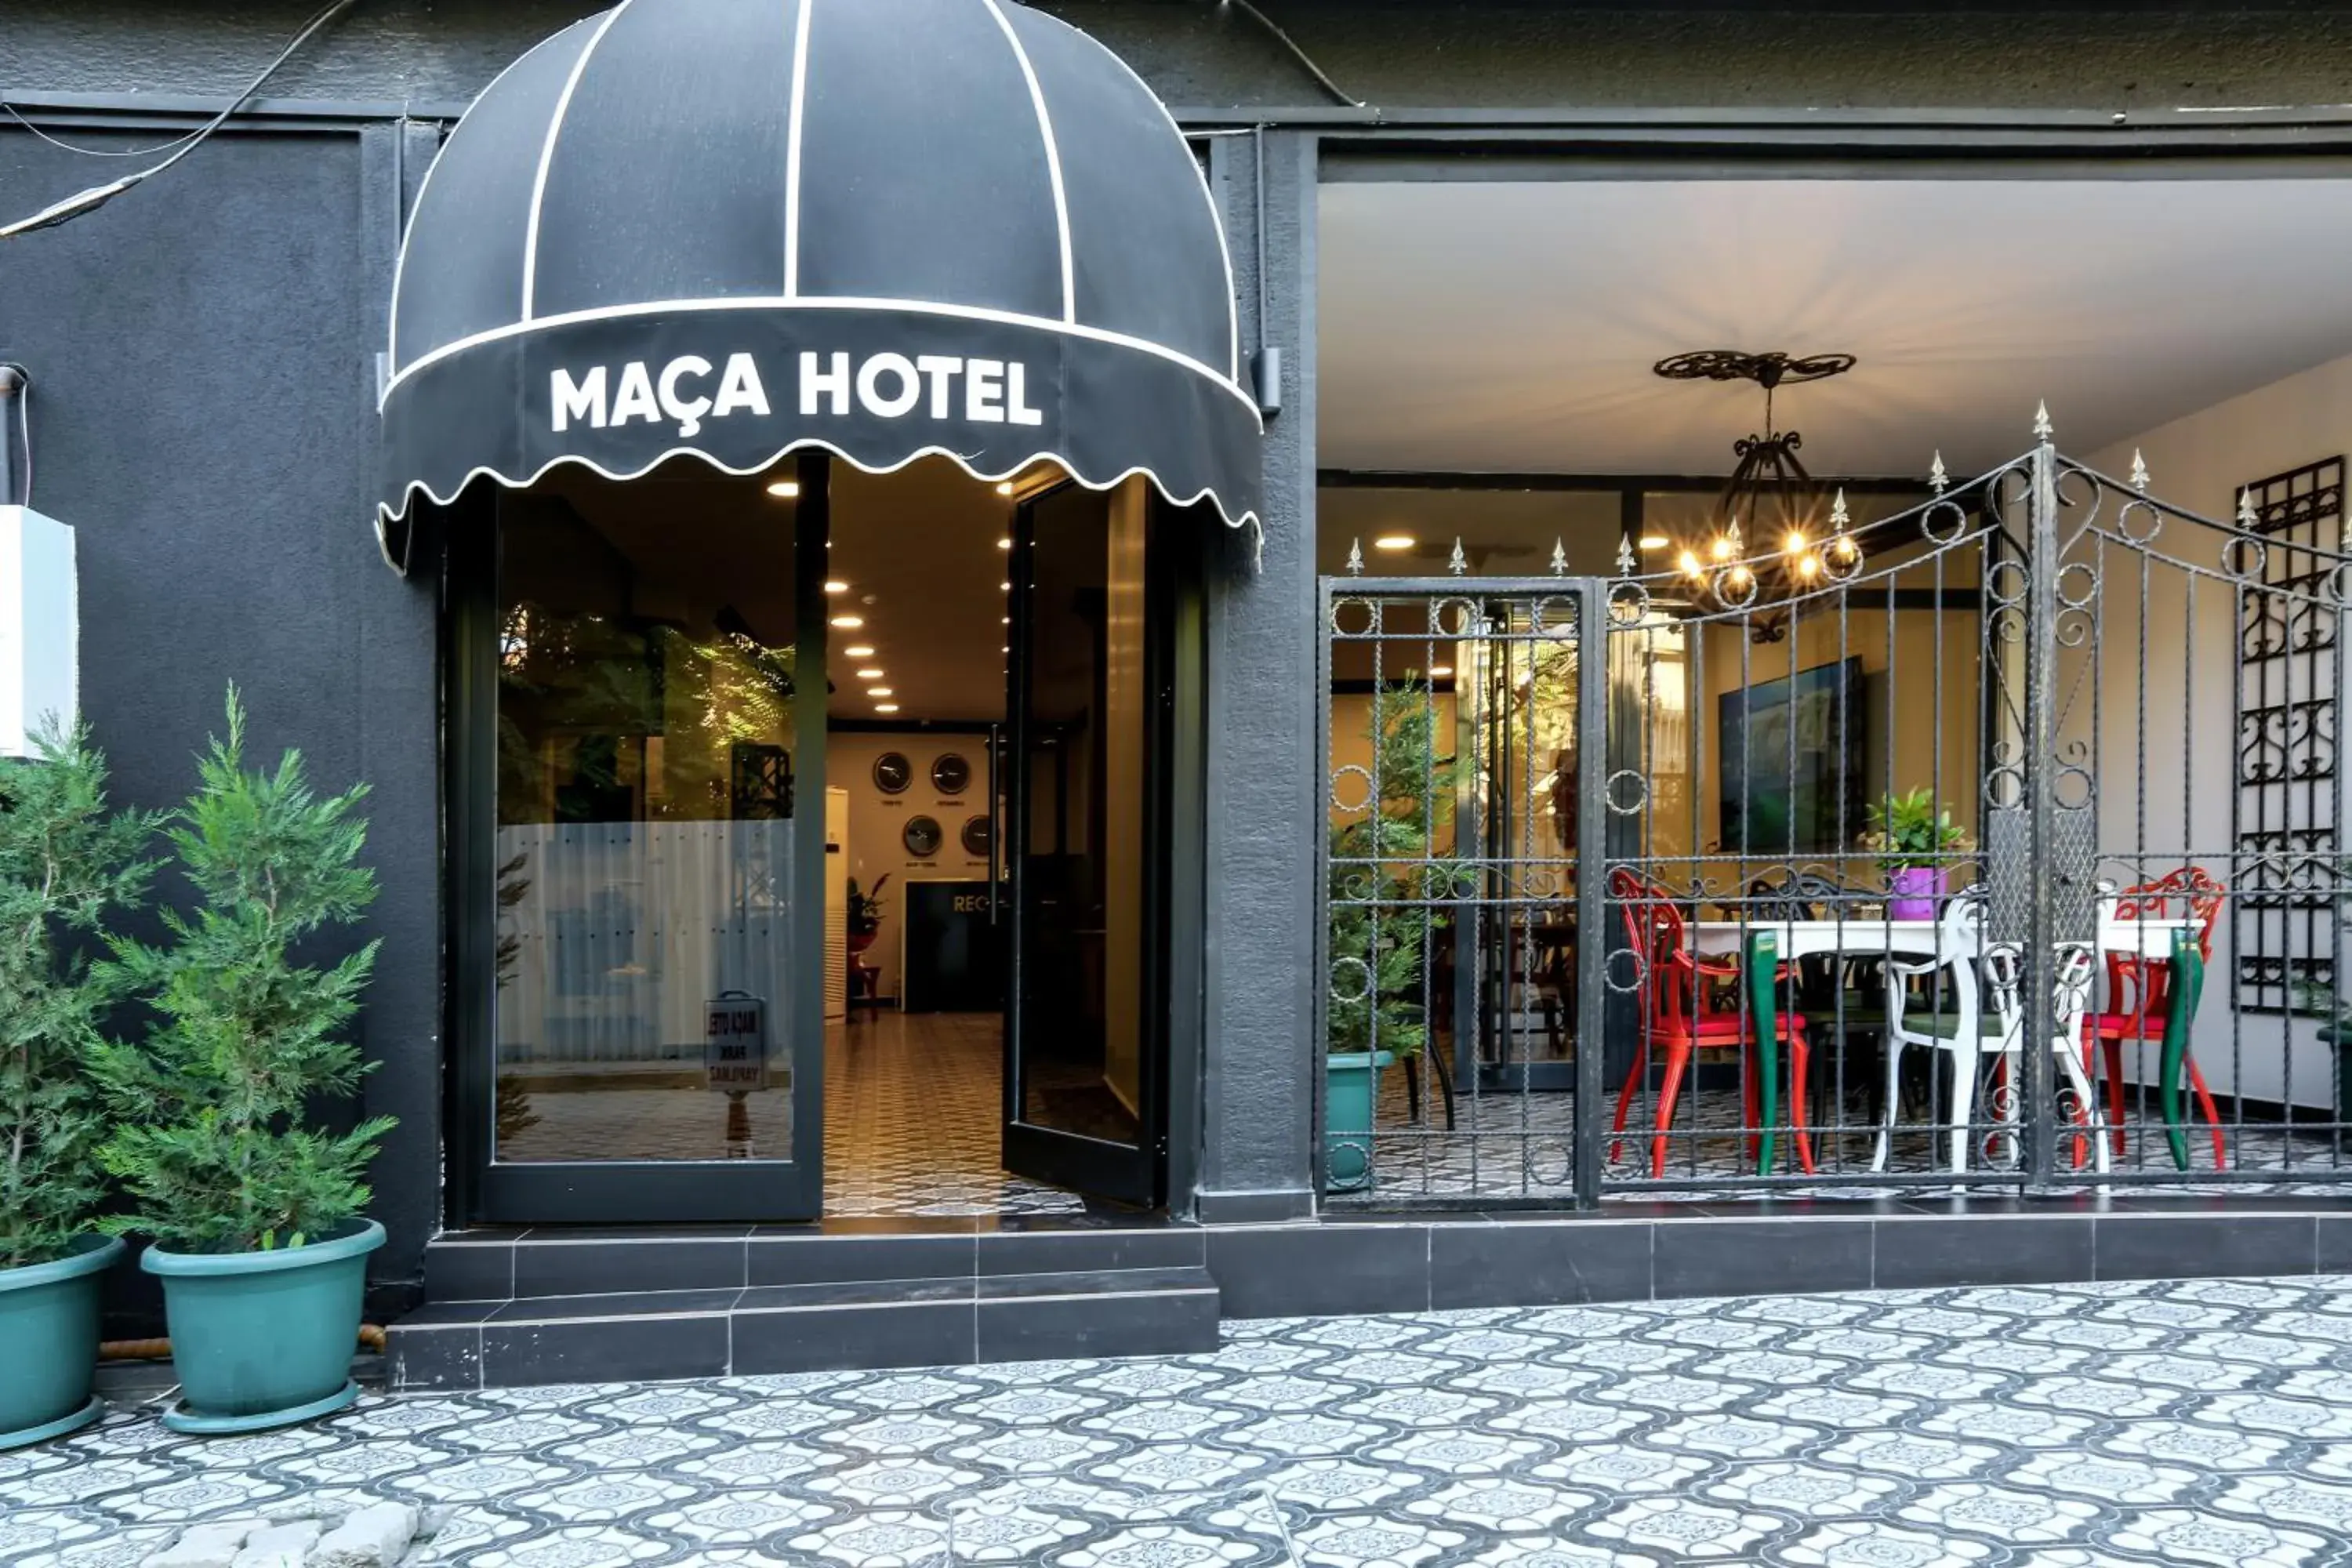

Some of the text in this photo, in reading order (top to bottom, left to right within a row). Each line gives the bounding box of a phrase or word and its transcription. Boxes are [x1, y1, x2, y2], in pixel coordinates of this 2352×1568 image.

[550, 351, 1043, 437] MAÇA HOTEL
[953, 895, 988, 913] REC
